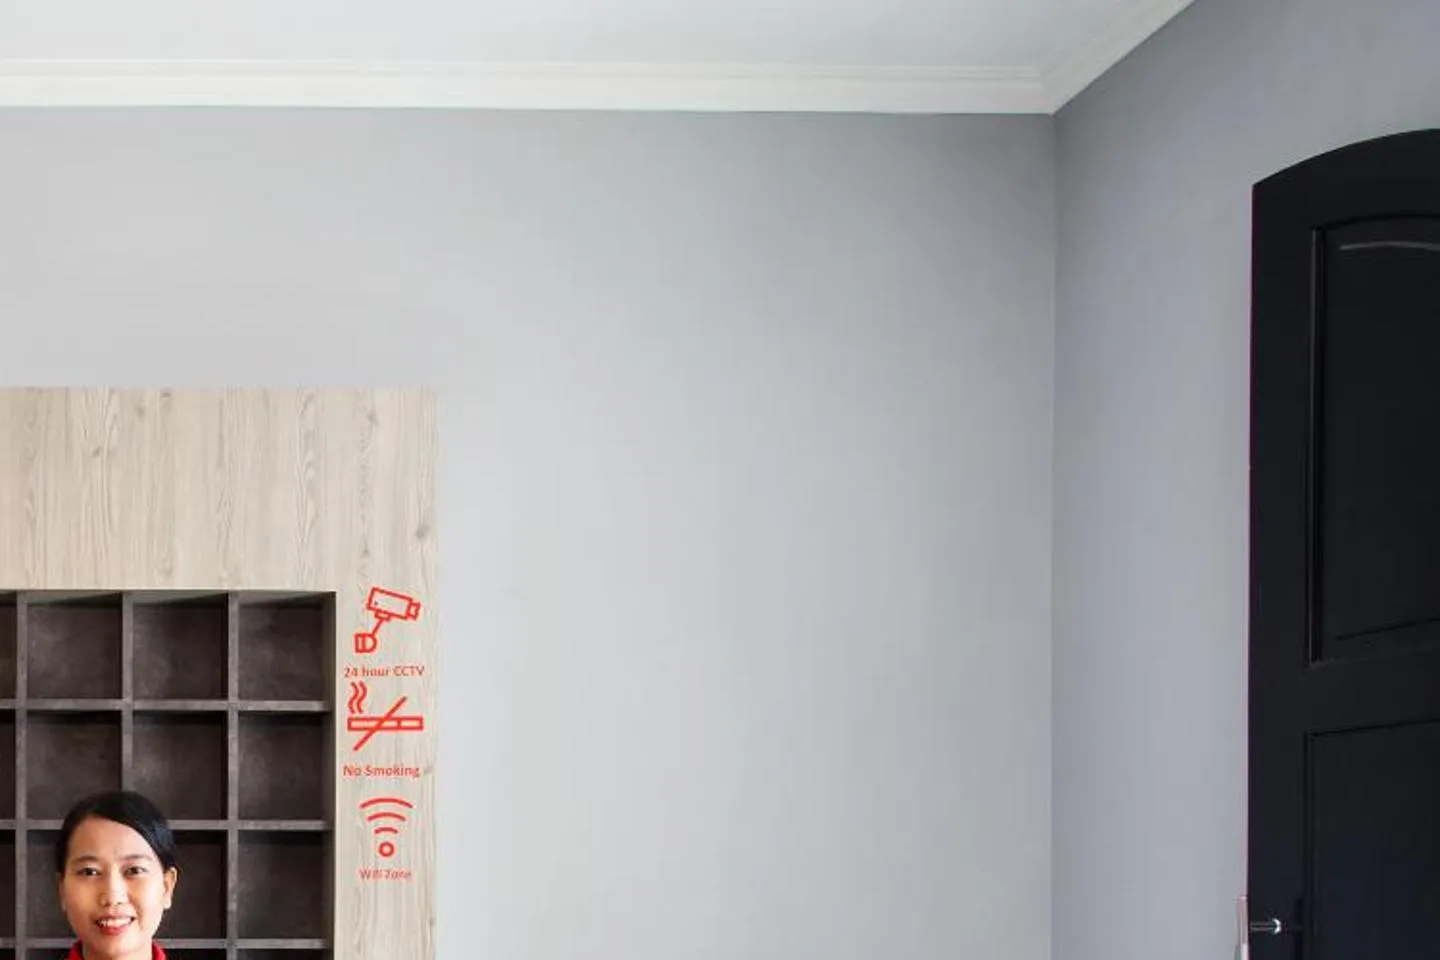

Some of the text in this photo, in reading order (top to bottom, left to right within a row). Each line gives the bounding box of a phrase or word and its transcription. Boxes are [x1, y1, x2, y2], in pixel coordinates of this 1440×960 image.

[344, 665, 425, 677] 24 hour CCTV
[343, 764, 420, 778] No Smoking
